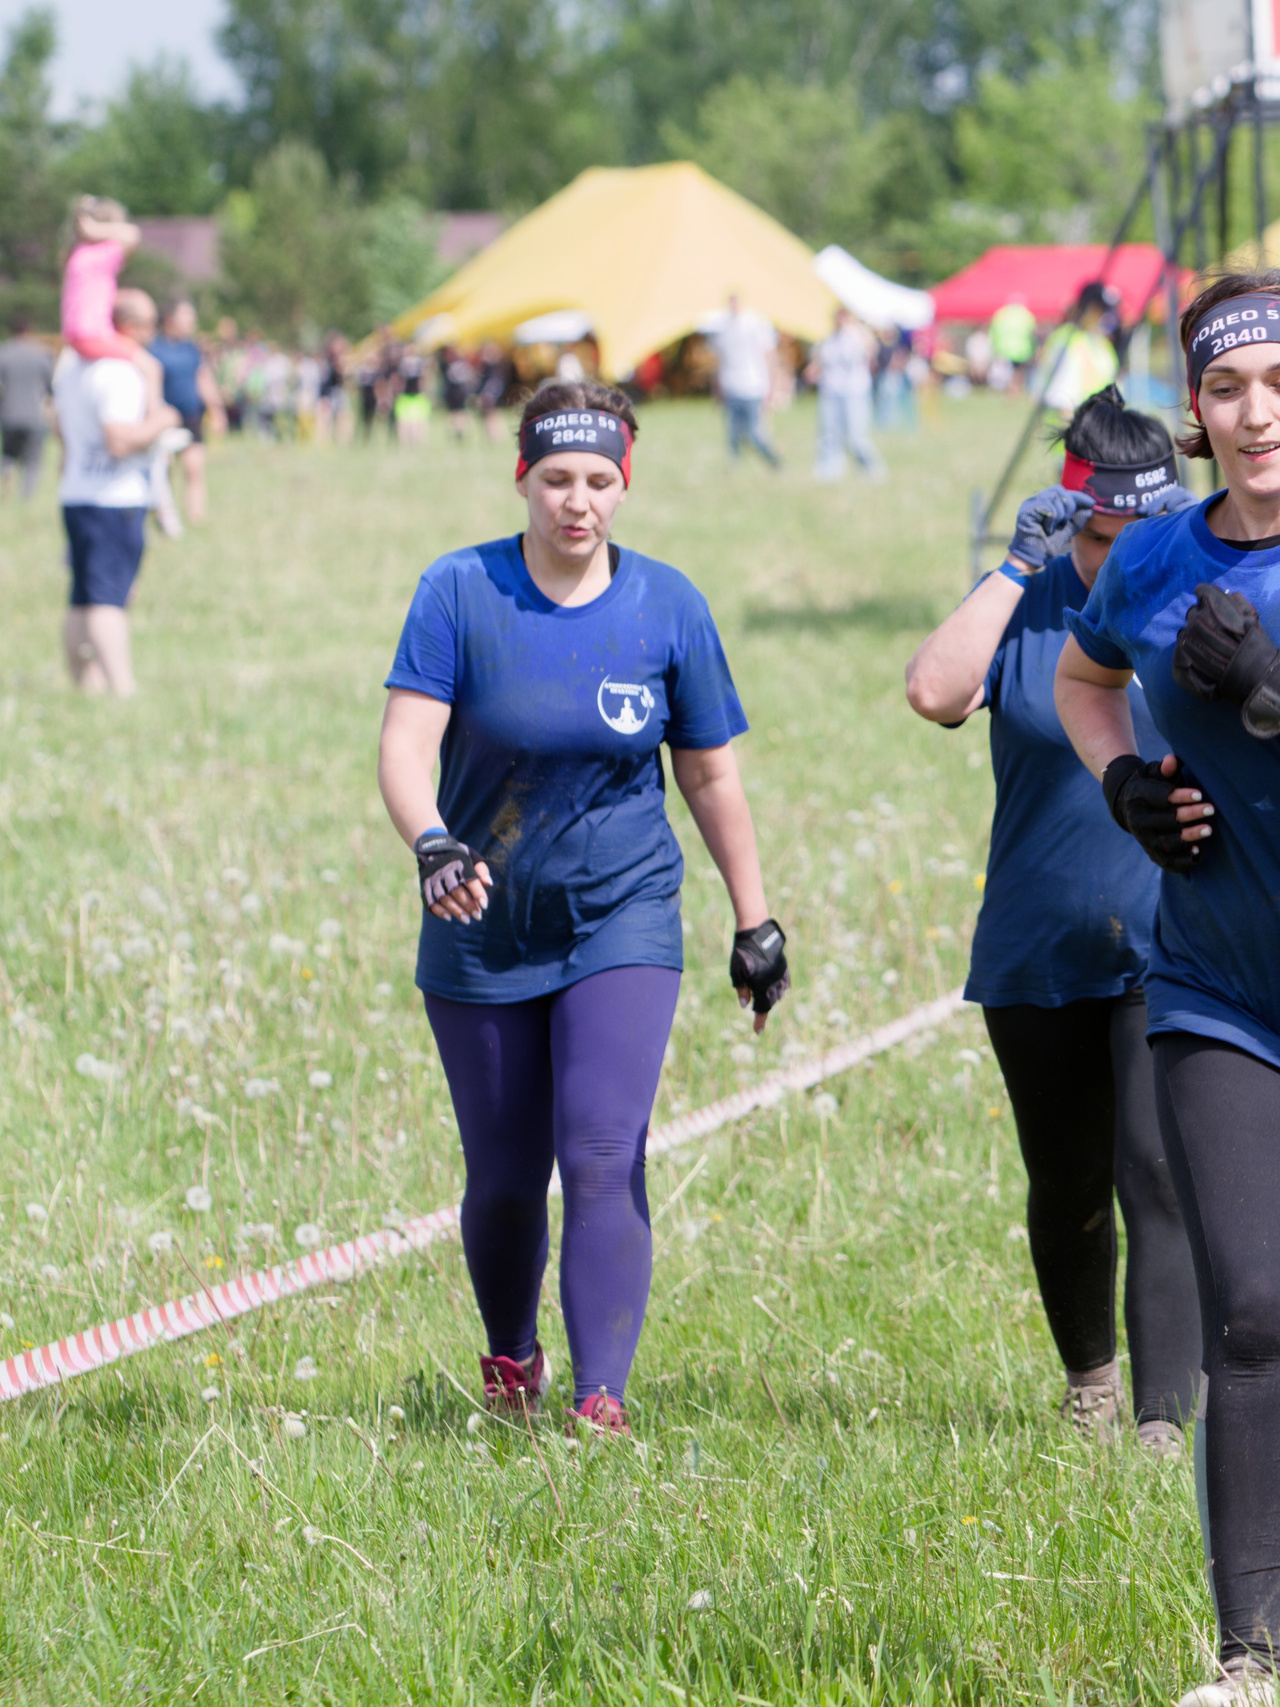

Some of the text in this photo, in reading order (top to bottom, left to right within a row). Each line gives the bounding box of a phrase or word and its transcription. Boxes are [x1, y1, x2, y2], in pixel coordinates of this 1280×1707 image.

[1192, 309, 1259, 353] РОДЕО
[1210, 326, 1268, 355] 2840
[534, 413, 617, 435] РОДЕО 59
[551, 429, 598, 445] 2842
[1113, 494, 1137, 508] 59
